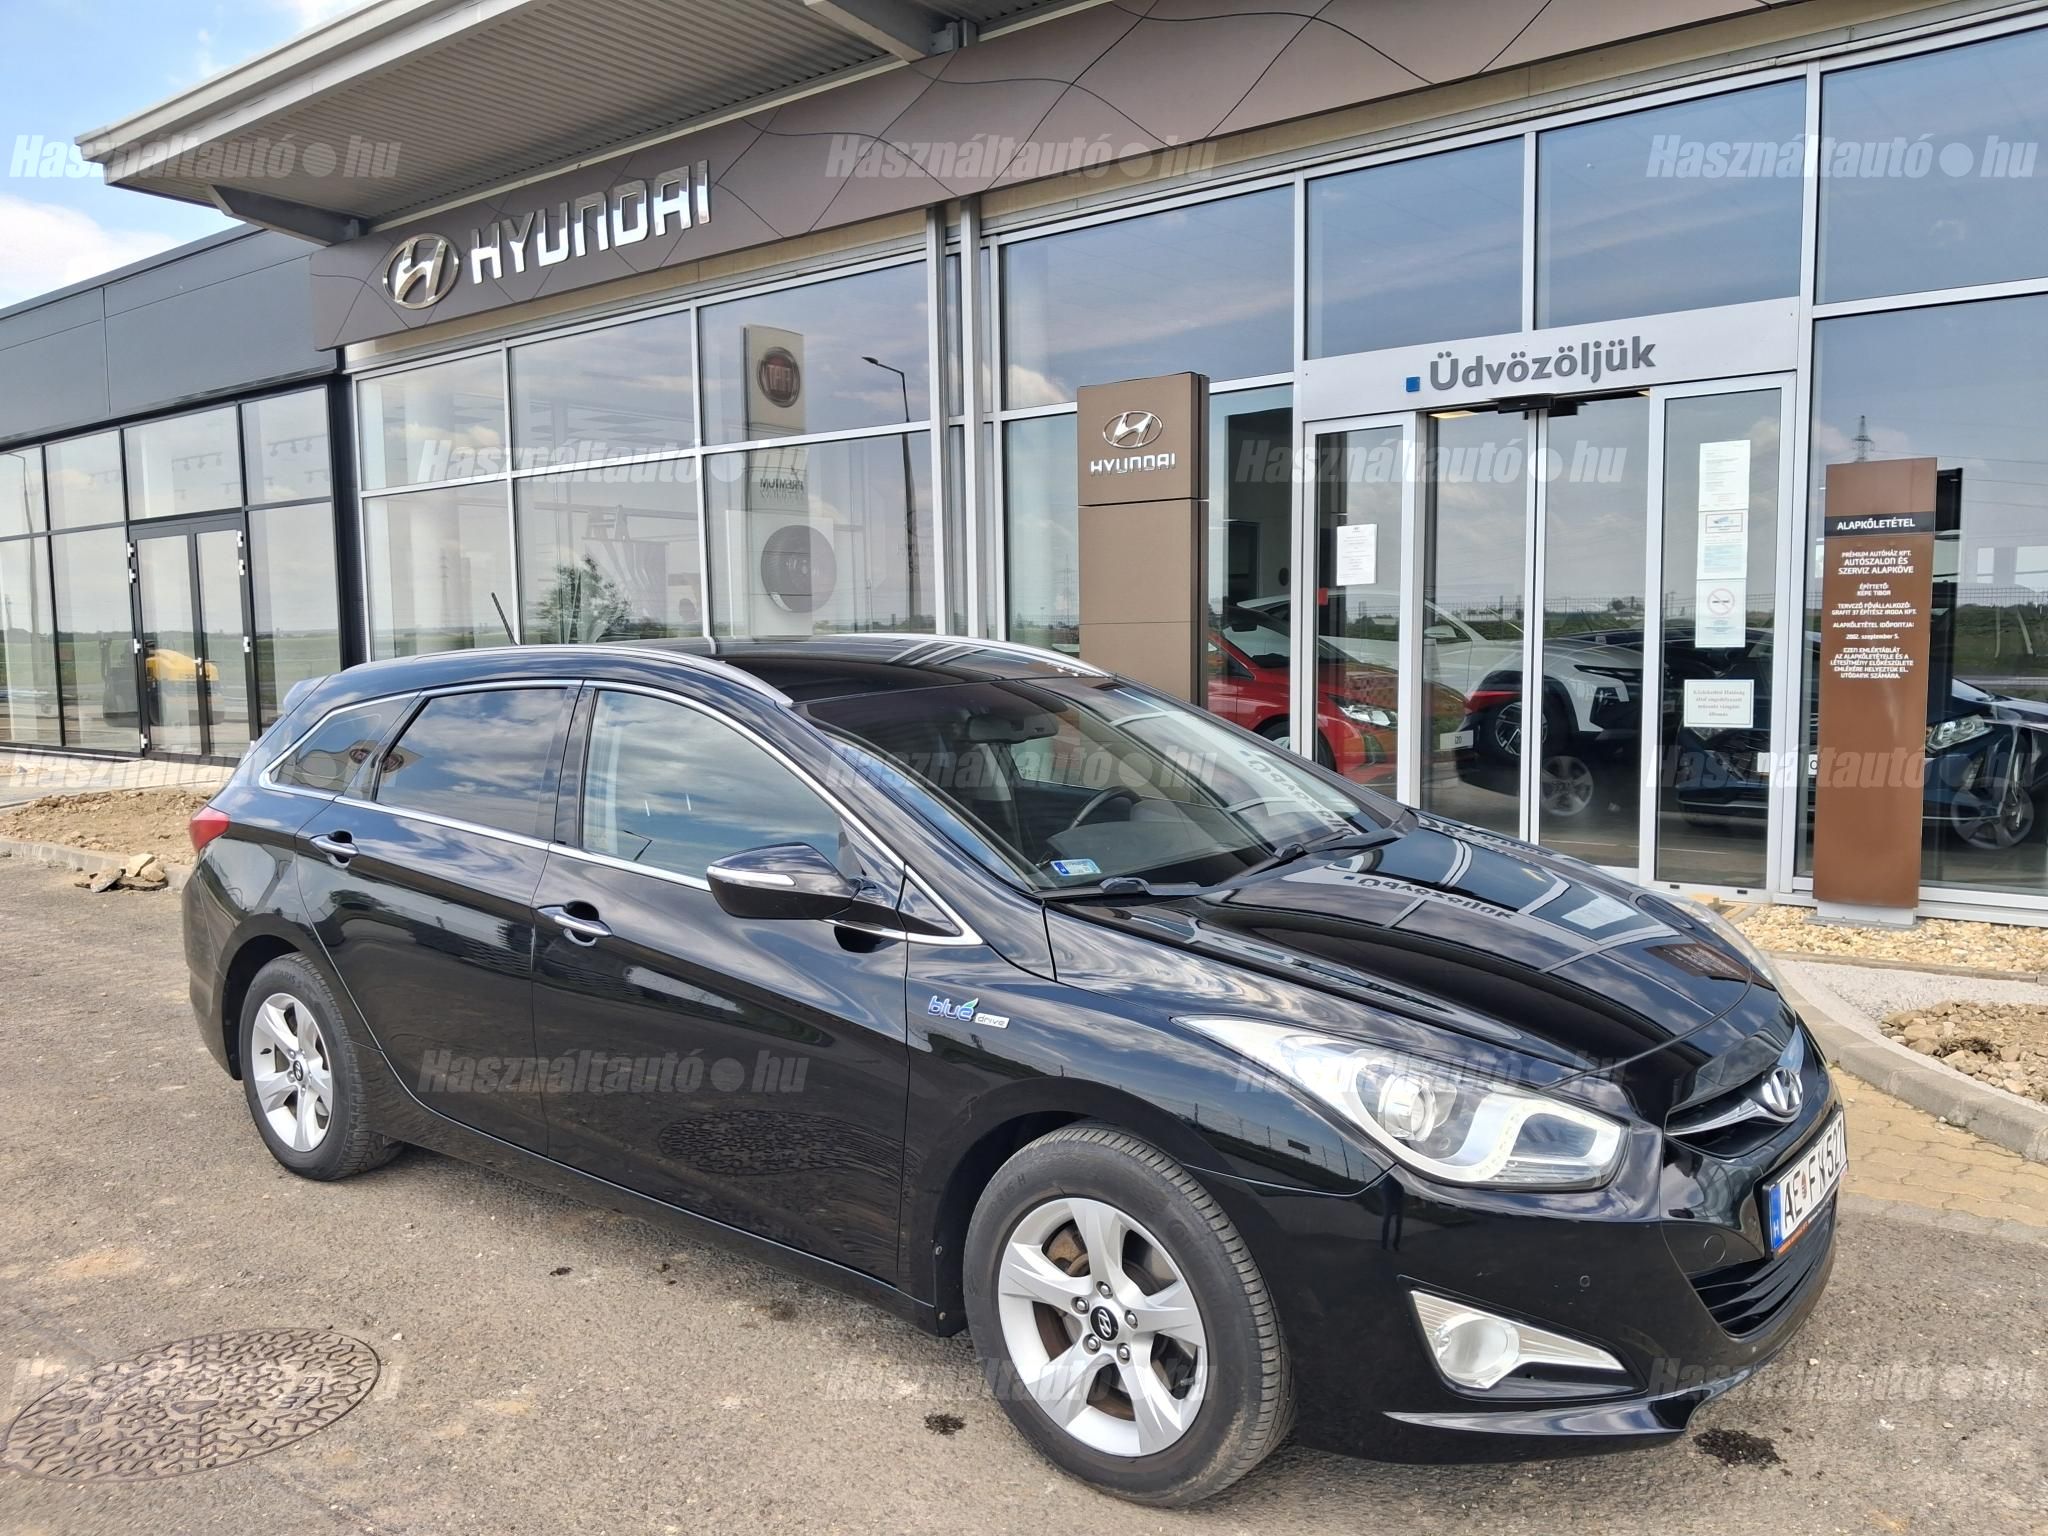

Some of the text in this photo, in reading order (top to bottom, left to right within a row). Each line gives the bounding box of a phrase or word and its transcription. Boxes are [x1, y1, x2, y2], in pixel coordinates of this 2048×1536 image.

[470, 159, 711, 284] HYUNDAI
[1430, 335, 1656, 391] Üdvözöljük
[1090, 453, 1176, 473] HYUNDAI
[1836, 516, 1916, 530] ALAPKŐLETÉTEL
[1838, 567, 1870, 575] SZERVIZ
[1844, 556, 1908, 566] AUTÓSZALON ÉS
[928, 995, 1006, 1026] blue drive
[1783, 1170, 1803, 1229] AE
